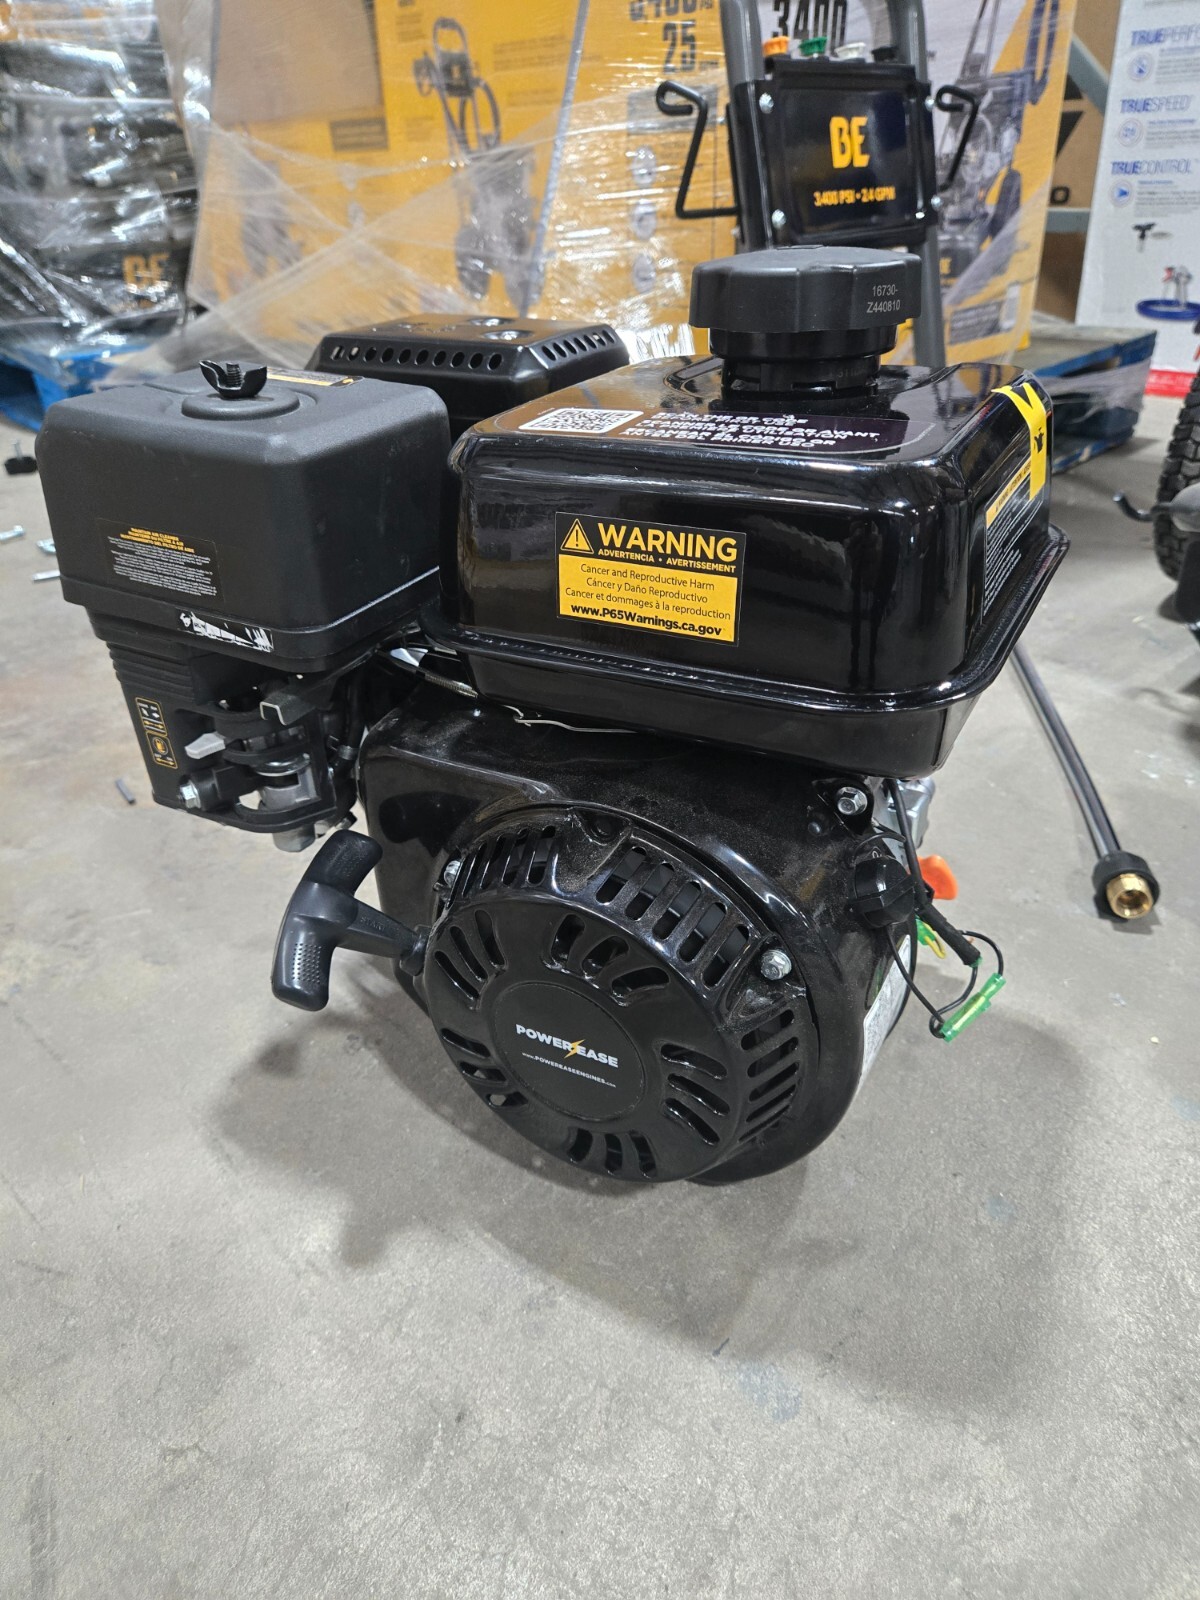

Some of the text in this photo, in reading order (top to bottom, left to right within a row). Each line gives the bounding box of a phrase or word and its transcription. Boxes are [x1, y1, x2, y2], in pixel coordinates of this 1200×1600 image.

[829, 116, 871, 169] BE
[872, 284, 898, 297] 16730-
[597, 522, 738, 563] WARNING
[597, 549, 737, 573] ADVERTENCIA AVERTISSEMENT
[580, 563, 715, 591] Cancer and Reproductive Harm
[586, 577, 708, 604] Cáncer y Daño Reproductivo
[565, 587, 731, 621] Cancer et dommages à la reproduction
[571, 604, 722, 636] www.P65Warnings.ca.gov
